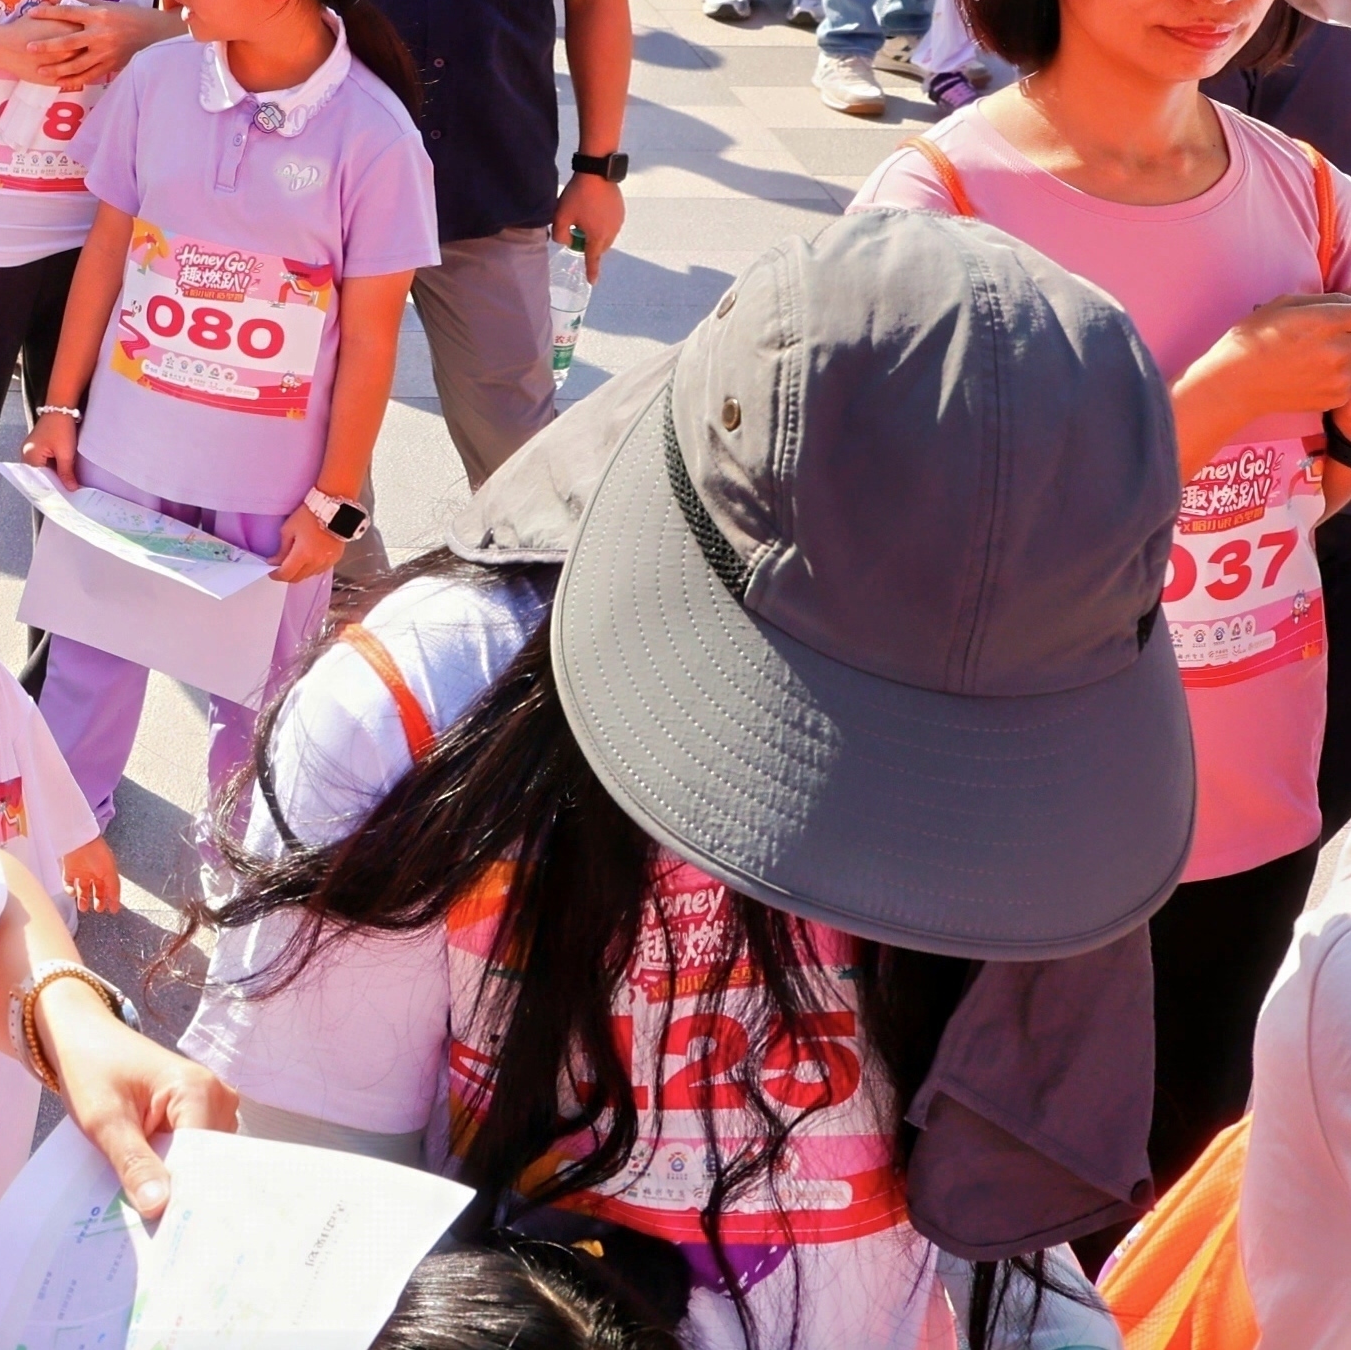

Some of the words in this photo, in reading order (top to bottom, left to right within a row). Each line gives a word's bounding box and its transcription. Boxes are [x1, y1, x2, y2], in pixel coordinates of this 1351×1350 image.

[176, 244, 227, 267] Honey
[225, 252, 255, 274] Go!
[177, 265, 252, 293] 趣燃趴!
[146, 294, 285, 359] 080
[1239, 450, 1273, 480] Go!
[1161, 527, 1299, 603] 037
[577, 1010, 861, 1110] 125
